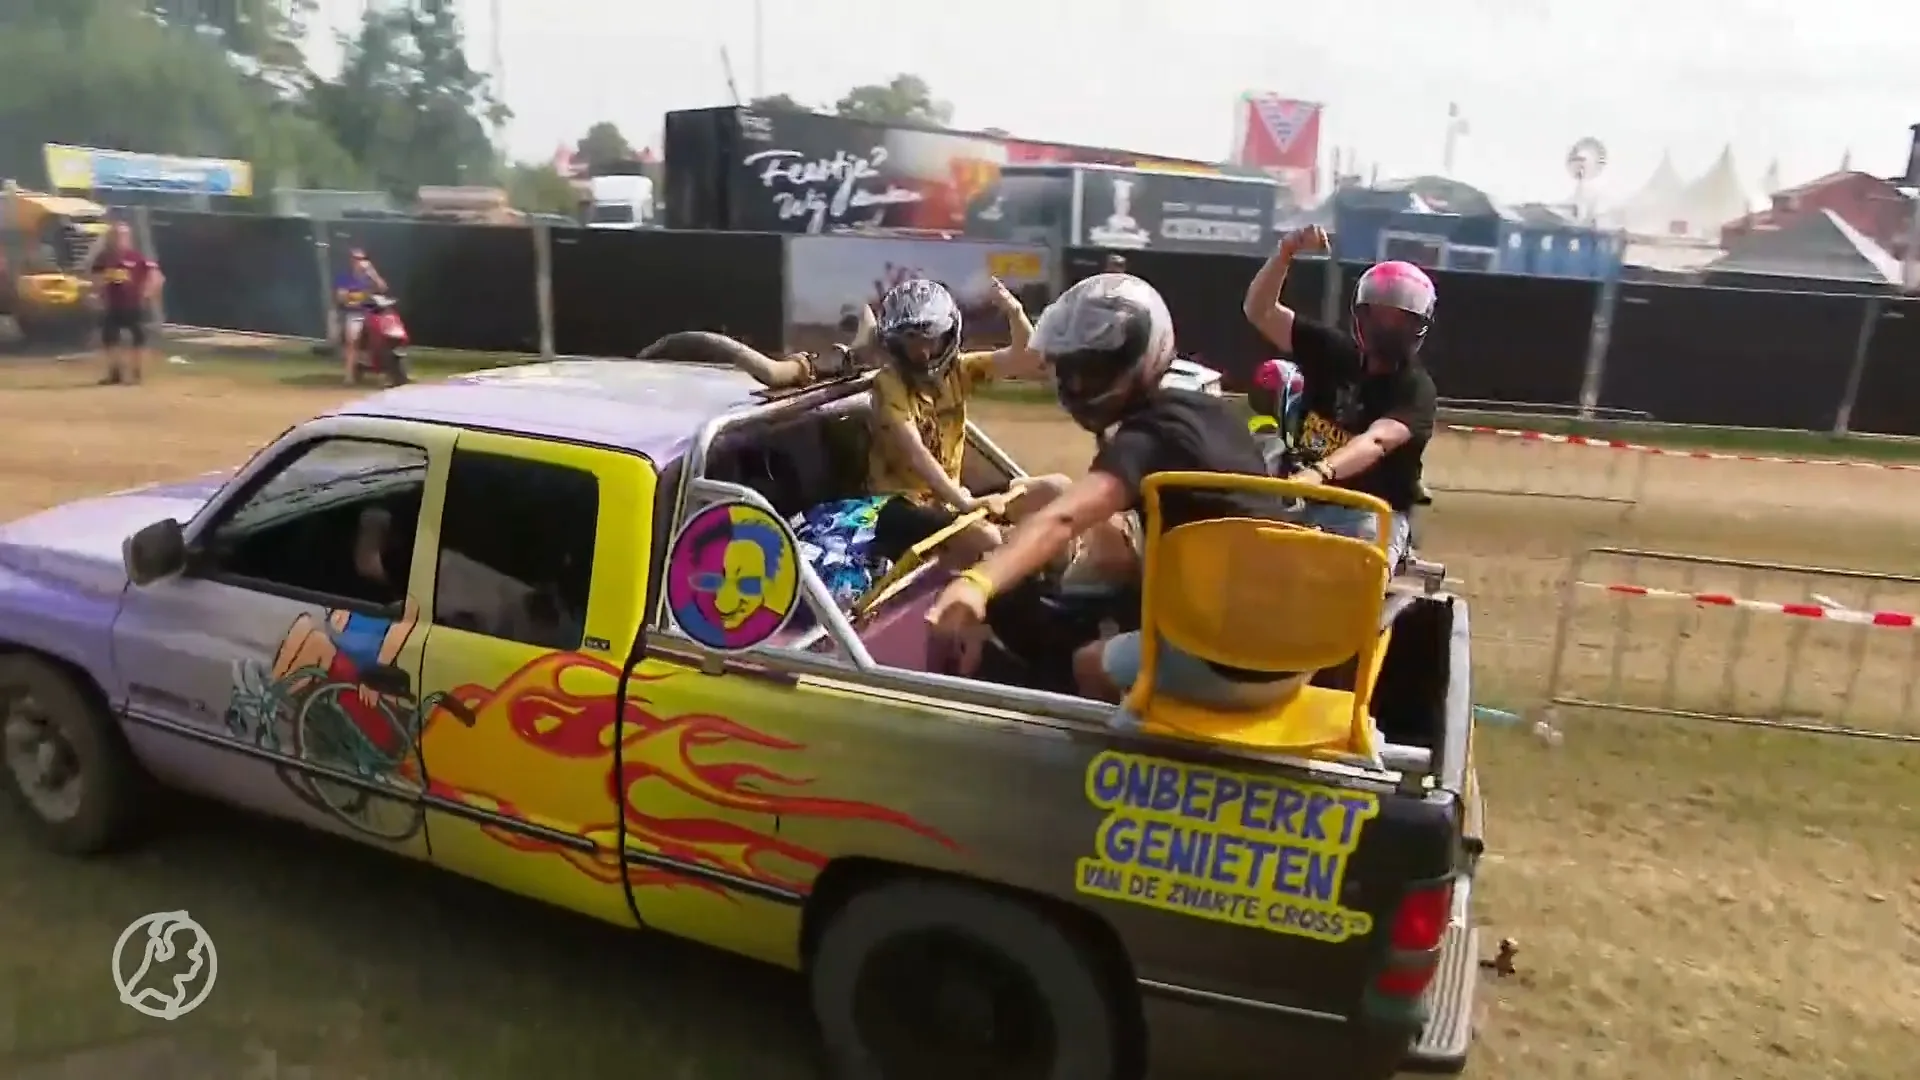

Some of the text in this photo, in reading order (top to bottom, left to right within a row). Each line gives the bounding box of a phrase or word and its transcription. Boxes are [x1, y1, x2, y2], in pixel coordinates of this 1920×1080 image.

[1094, 759, 1370, 844] ONBEPERKT
[1084, 864, 1122, 891] VAN
[1128, 875, 1156, 899] DE
[1167, 882, 1261, 919] ZWARTE
[1268, 903, 1344, 935] CROSS
[1105, 818, 1338, 901] GENIETEN
